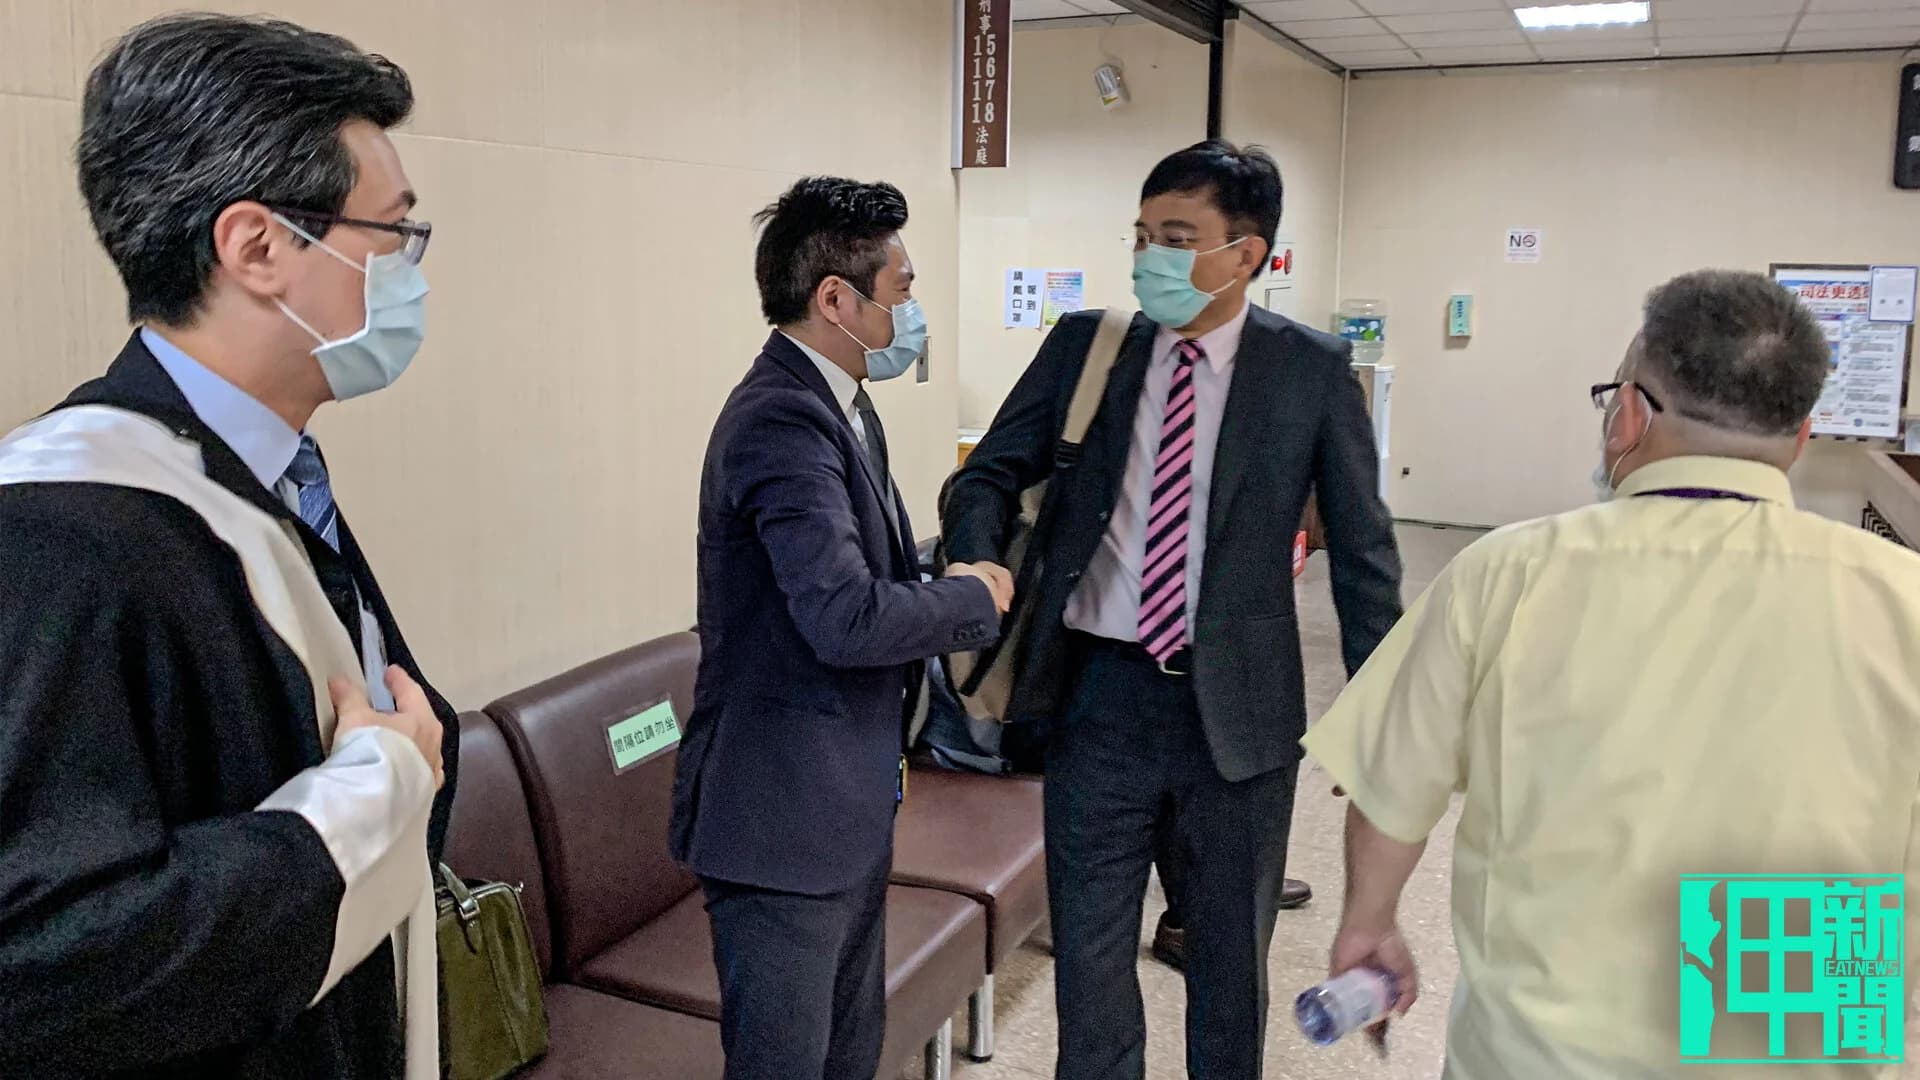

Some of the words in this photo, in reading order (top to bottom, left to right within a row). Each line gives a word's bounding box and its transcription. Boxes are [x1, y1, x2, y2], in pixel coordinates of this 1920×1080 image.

[973, 34, 997, 56] 15
[973, 57, 996, 79] 16
[972, 80, 995, 101] 17
[971, 102, 994, 123] 18
[975, 126, 989, 165] 法庭
